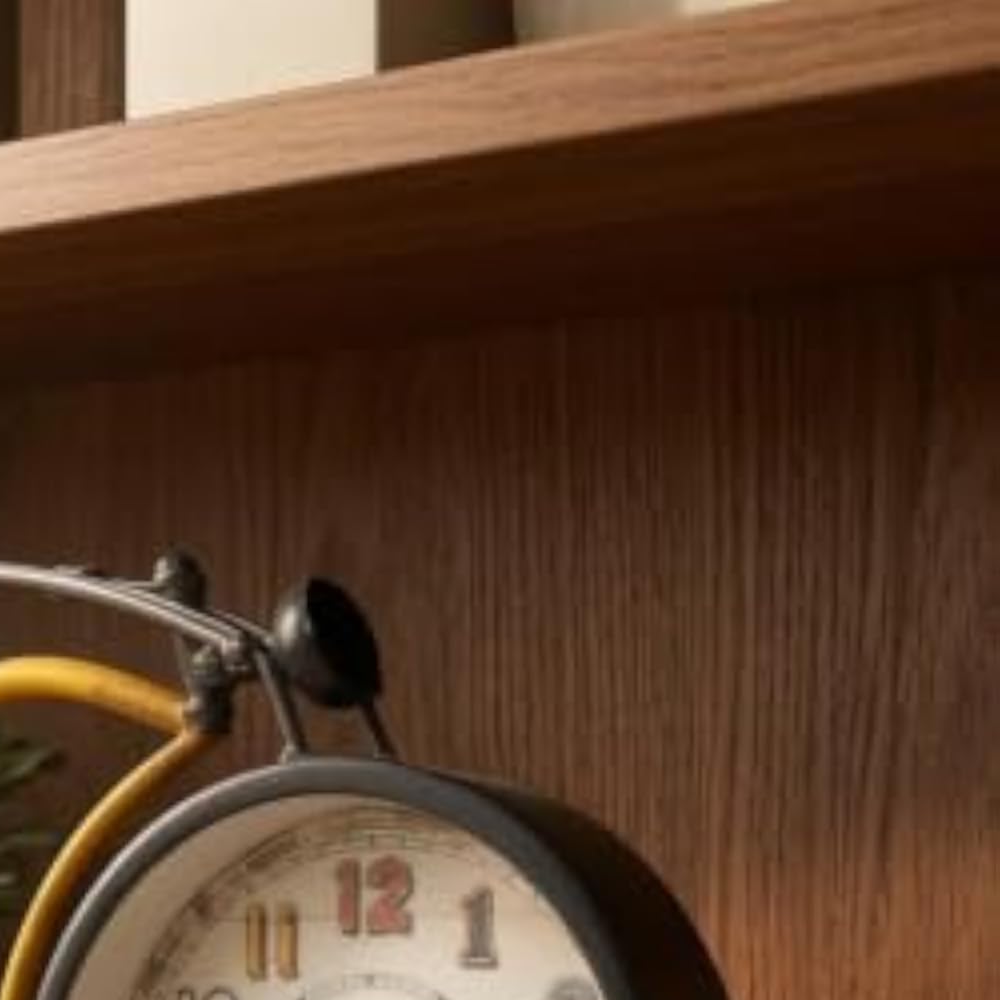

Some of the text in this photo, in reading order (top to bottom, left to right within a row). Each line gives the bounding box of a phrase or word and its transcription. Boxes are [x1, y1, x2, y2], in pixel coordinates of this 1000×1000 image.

[337, 854, 414, 936] 12
[460, 887, 497, 969] 1
[245, 903, 299, 981] 11
